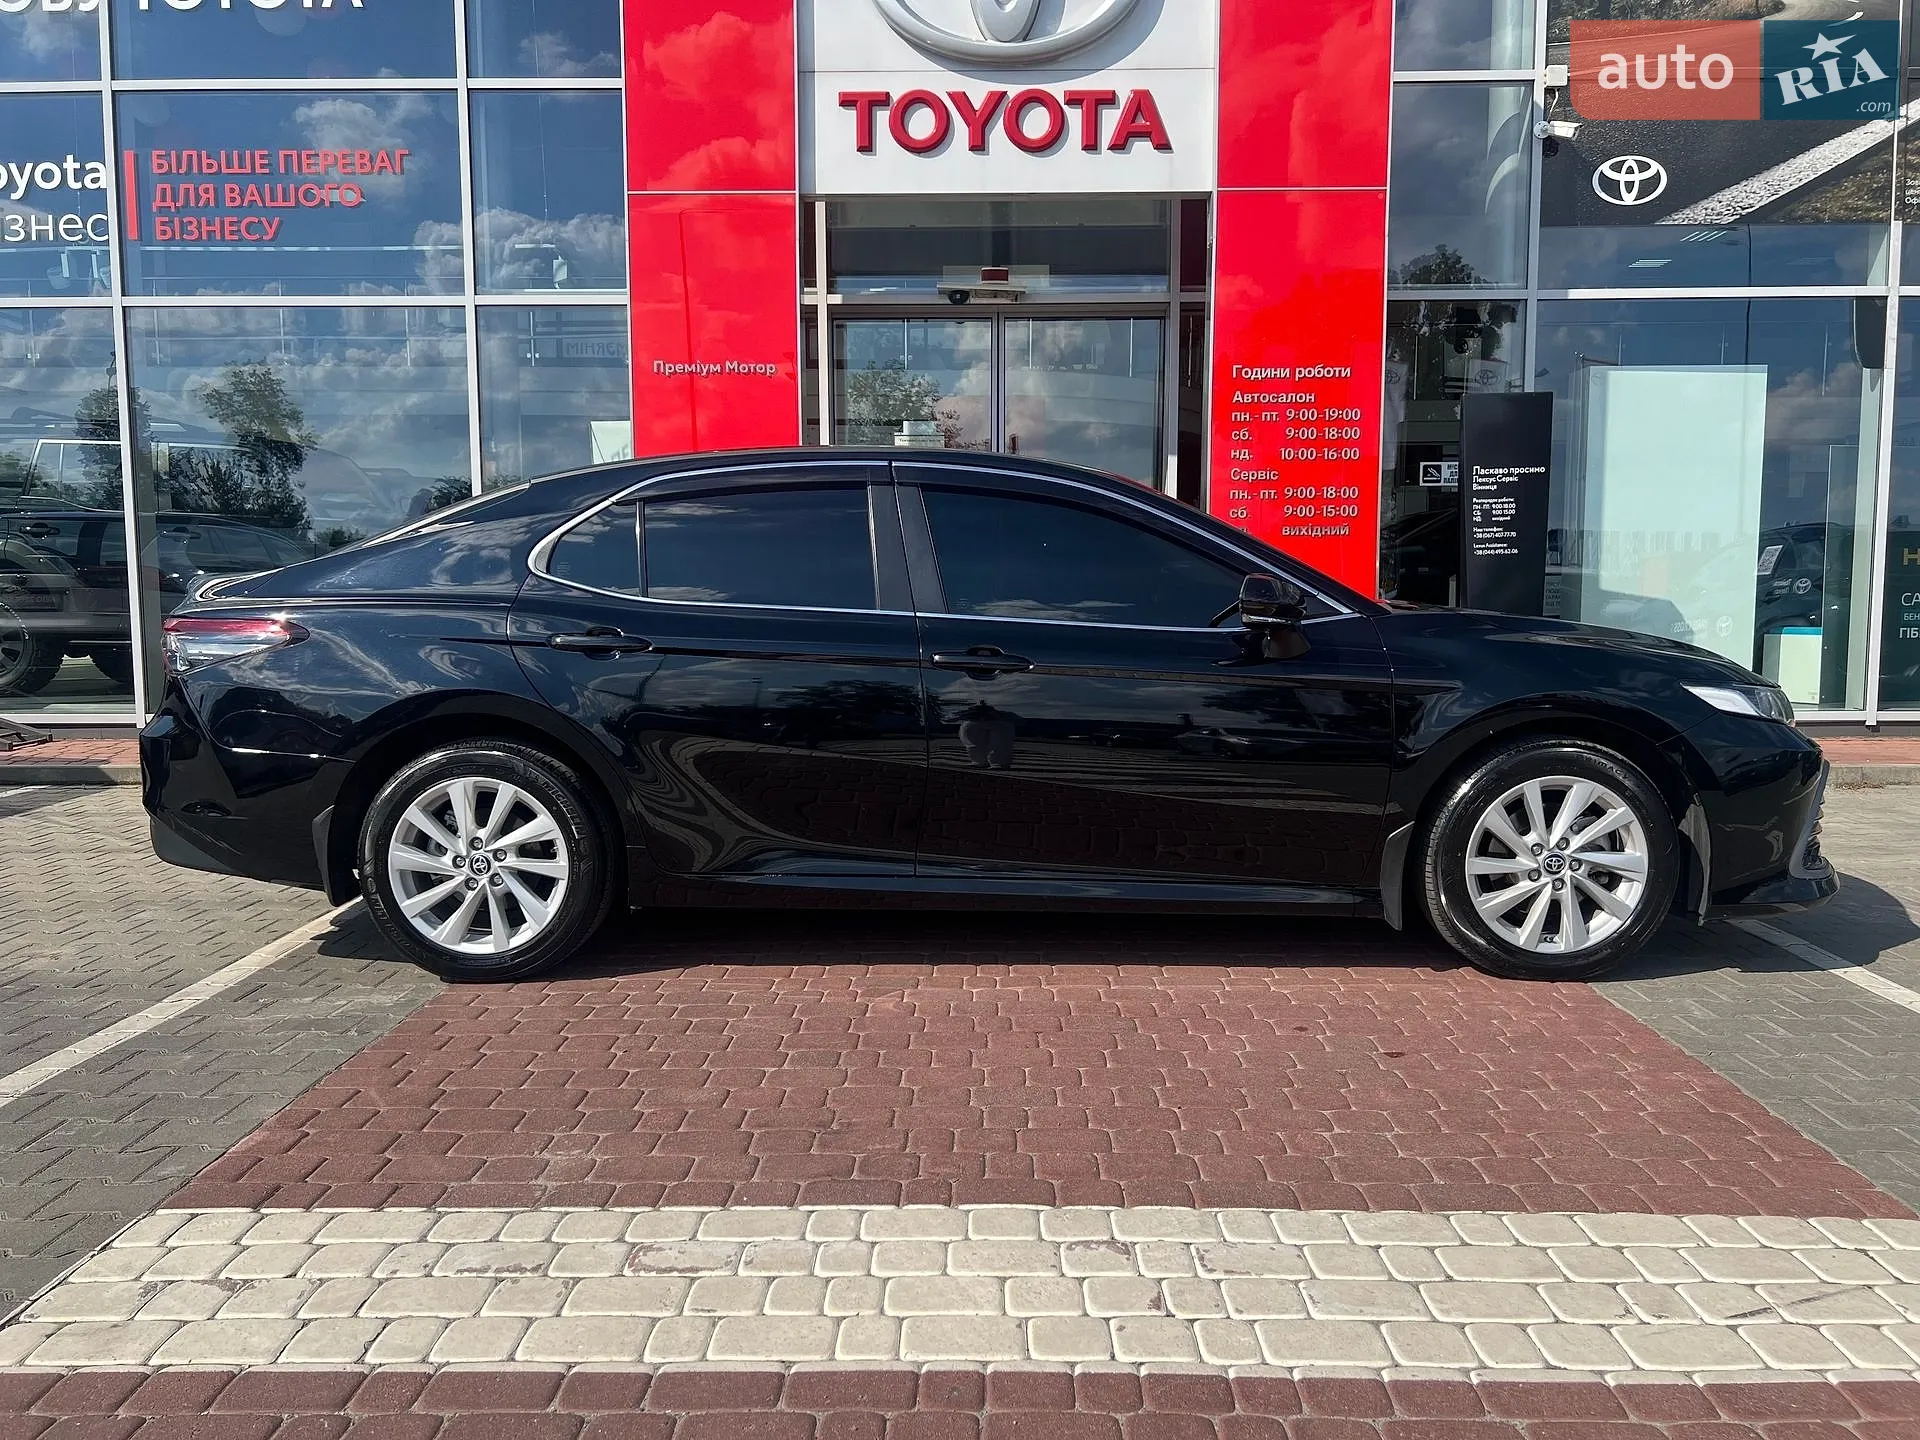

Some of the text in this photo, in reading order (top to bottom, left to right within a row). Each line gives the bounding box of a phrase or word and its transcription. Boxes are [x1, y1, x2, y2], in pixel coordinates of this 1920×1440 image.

[838, 89, 1172, 153] TOYOTA
[152, 149, 409, 174] БІЛЬШЕ ПЕРЕВАГ
[152, 183, 363, 213] ДЛЯ ВАШОГО
[155, 216, 280, 241] БІЗНЕСУ
[653, 360, 776, 376] Преміум Мотор
[1232, 363, 1351, 381] Години роботи
[1232, 391, 1315, 403] Автосалон
[1285, 407, 1361, 421] 9:00-19:00
[1231, 426, 1361, 441] сб. 9:00-18:00
[1231, 447, 1360, 461] нд. 10:00-16:00
[1230, 467, 1279, 483] Сервіс
[1472, 465, 1546, 475] Ласкаво просимо
[1496, 475, 1519, 483] Сервіс
[1284, 486, 1359, 499] 9:00-18:00
[1283, 504, 1358, 517] 9:00-15:00
[1282, 523, 1350, 537] вихідний
